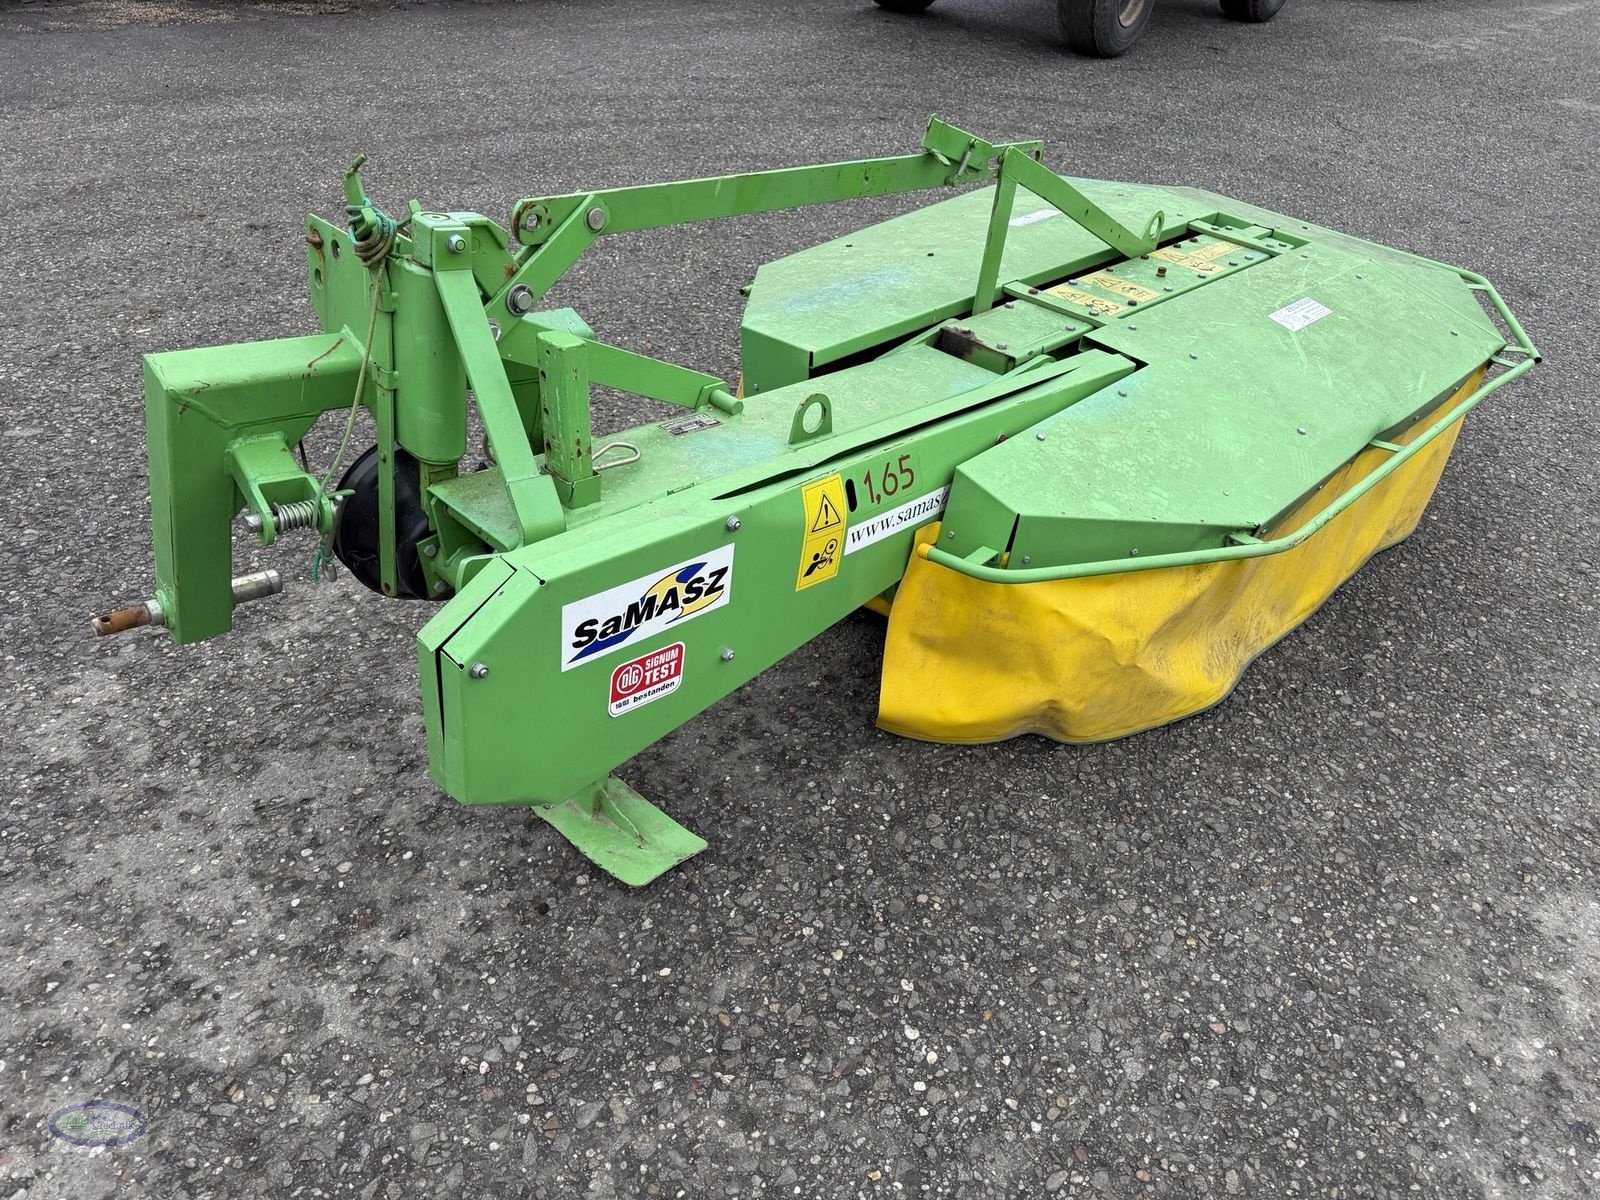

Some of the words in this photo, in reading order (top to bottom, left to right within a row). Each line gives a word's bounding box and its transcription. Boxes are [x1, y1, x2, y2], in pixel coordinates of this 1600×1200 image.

[863, 454, 915, 505] 1,65
[645, 647, 679, 670] SIGNUM
[621, 666, 640, 690] DLG
[644, 660, 678, 685] TEST
[633, 681, 675, 703] bestanden
